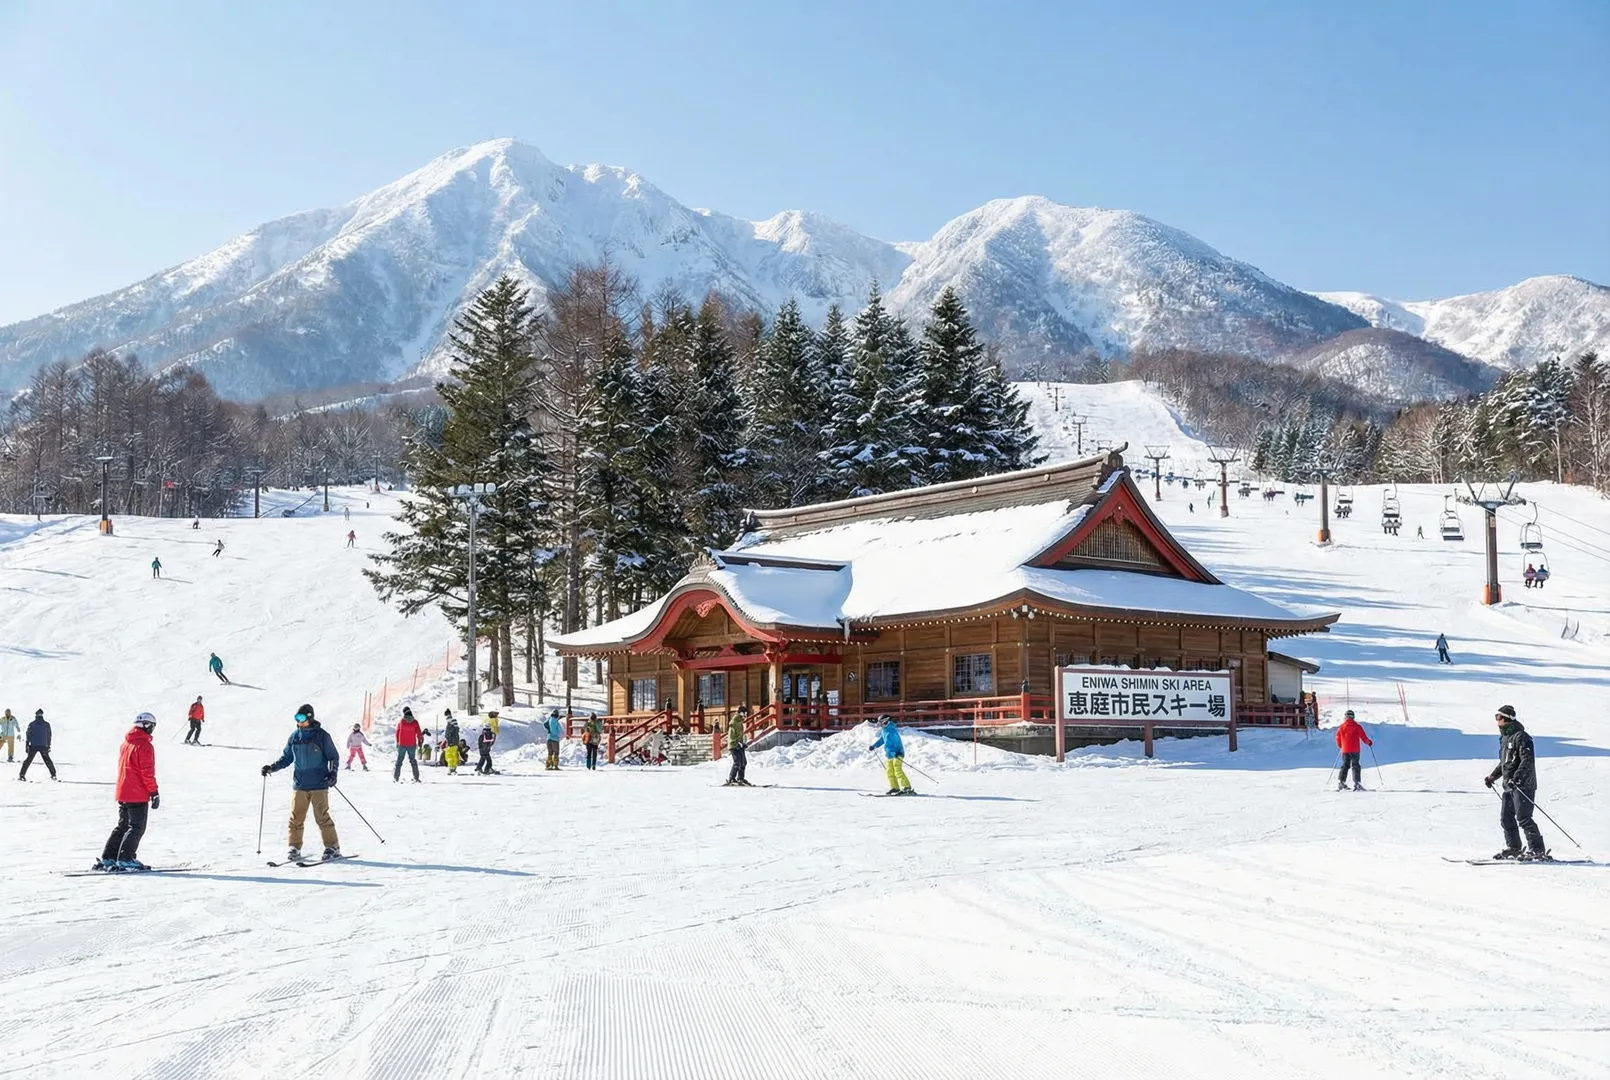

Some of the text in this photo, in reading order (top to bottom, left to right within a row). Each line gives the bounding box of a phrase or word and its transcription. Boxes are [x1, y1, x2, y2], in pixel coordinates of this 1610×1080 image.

[1082, 676, 1212, 691] ENIWA SHIMIN SKI AREA
[1068, 691, 1226, 718] 恵庭市民スキー場
